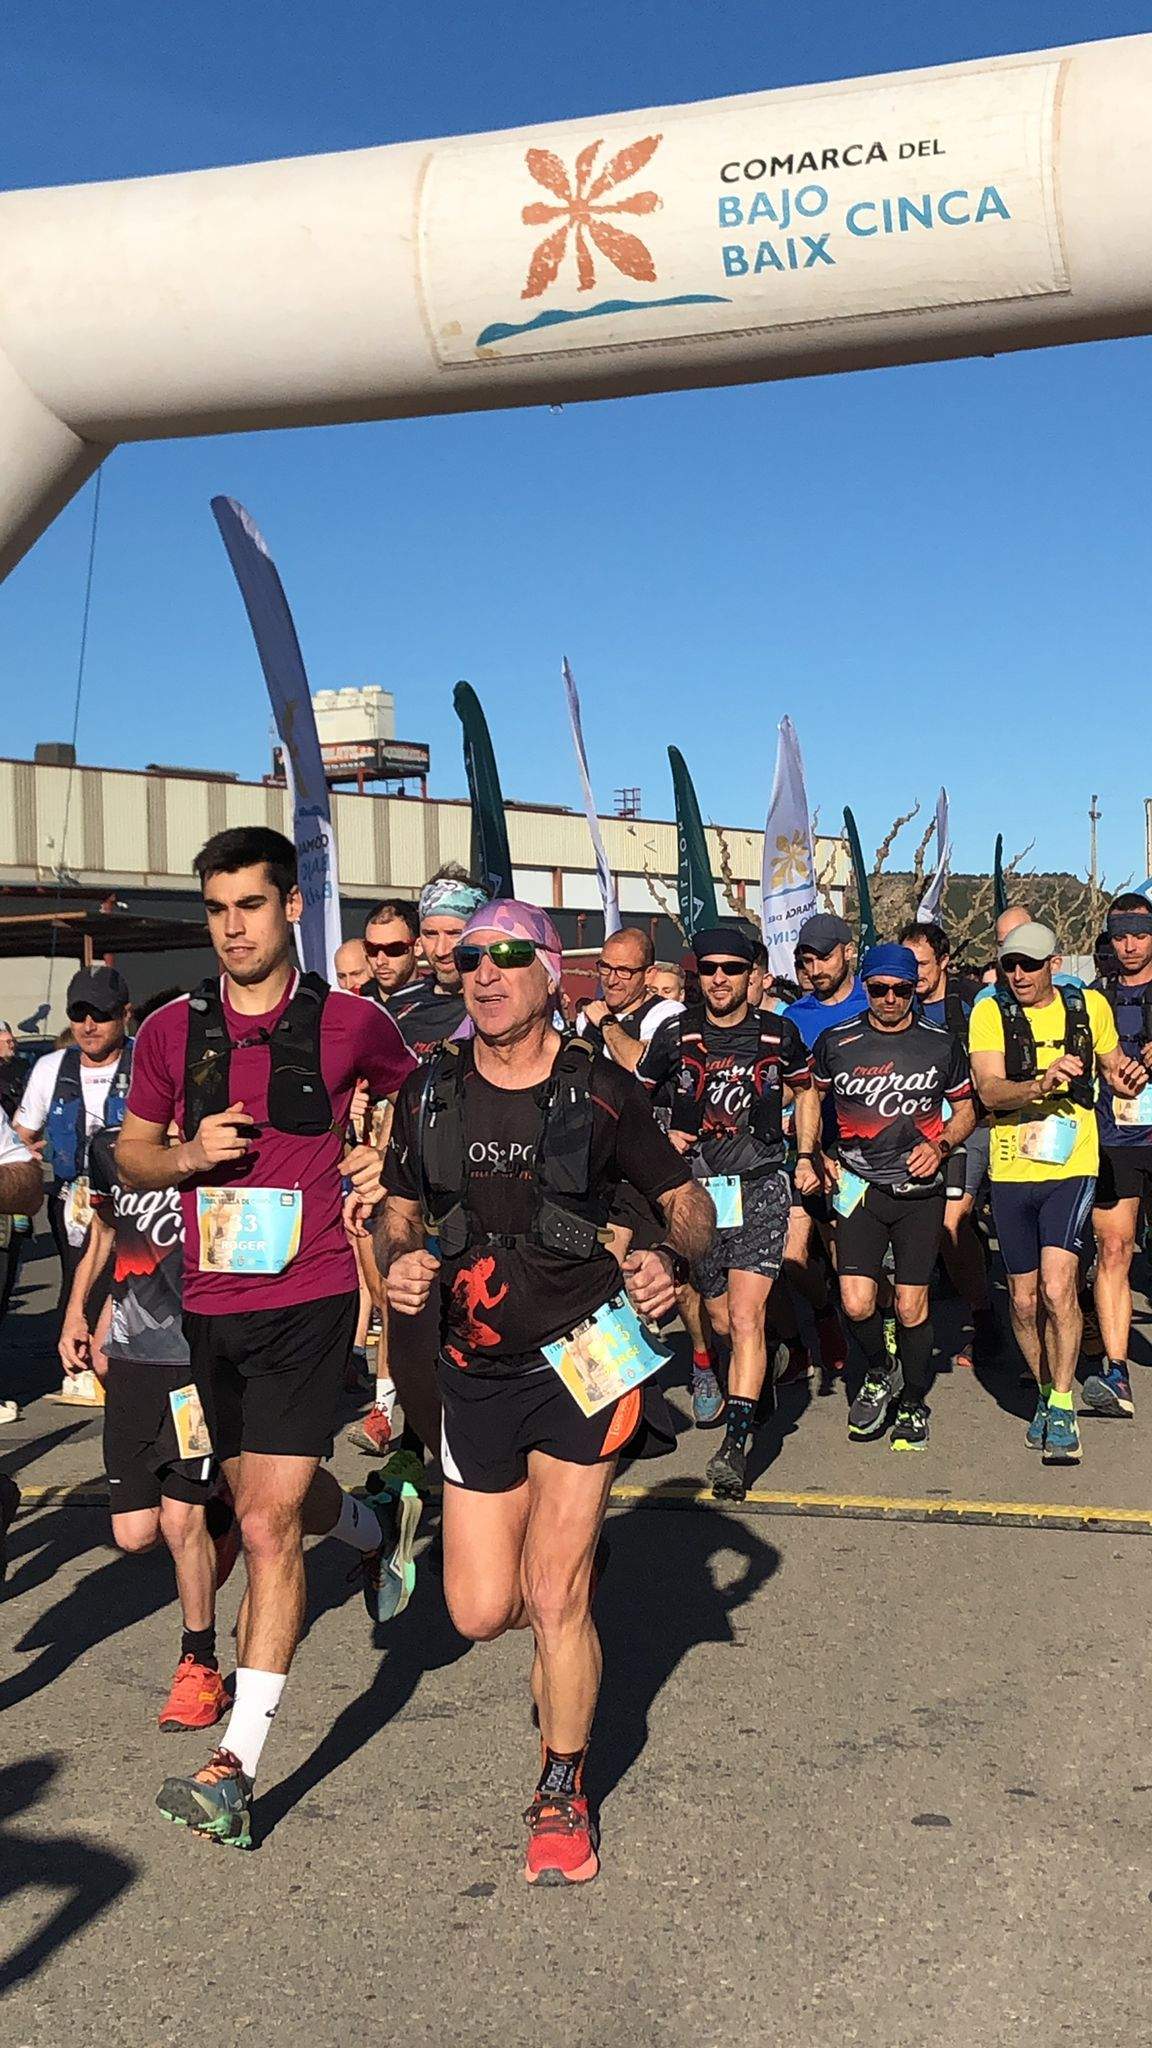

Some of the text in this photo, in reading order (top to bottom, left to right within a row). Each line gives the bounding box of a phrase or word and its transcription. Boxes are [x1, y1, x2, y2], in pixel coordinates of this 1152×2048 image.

[720, 139, 946, 183] COMARCA DEL
[718, 184, 829, 230] BAJO
[845, 185, 1011, 237] CINCA
[722, 233, 836, 277] BAIX
[879, 1091, 932, 1117] Cor
[221, 1240, 267, 1251] ROGER
